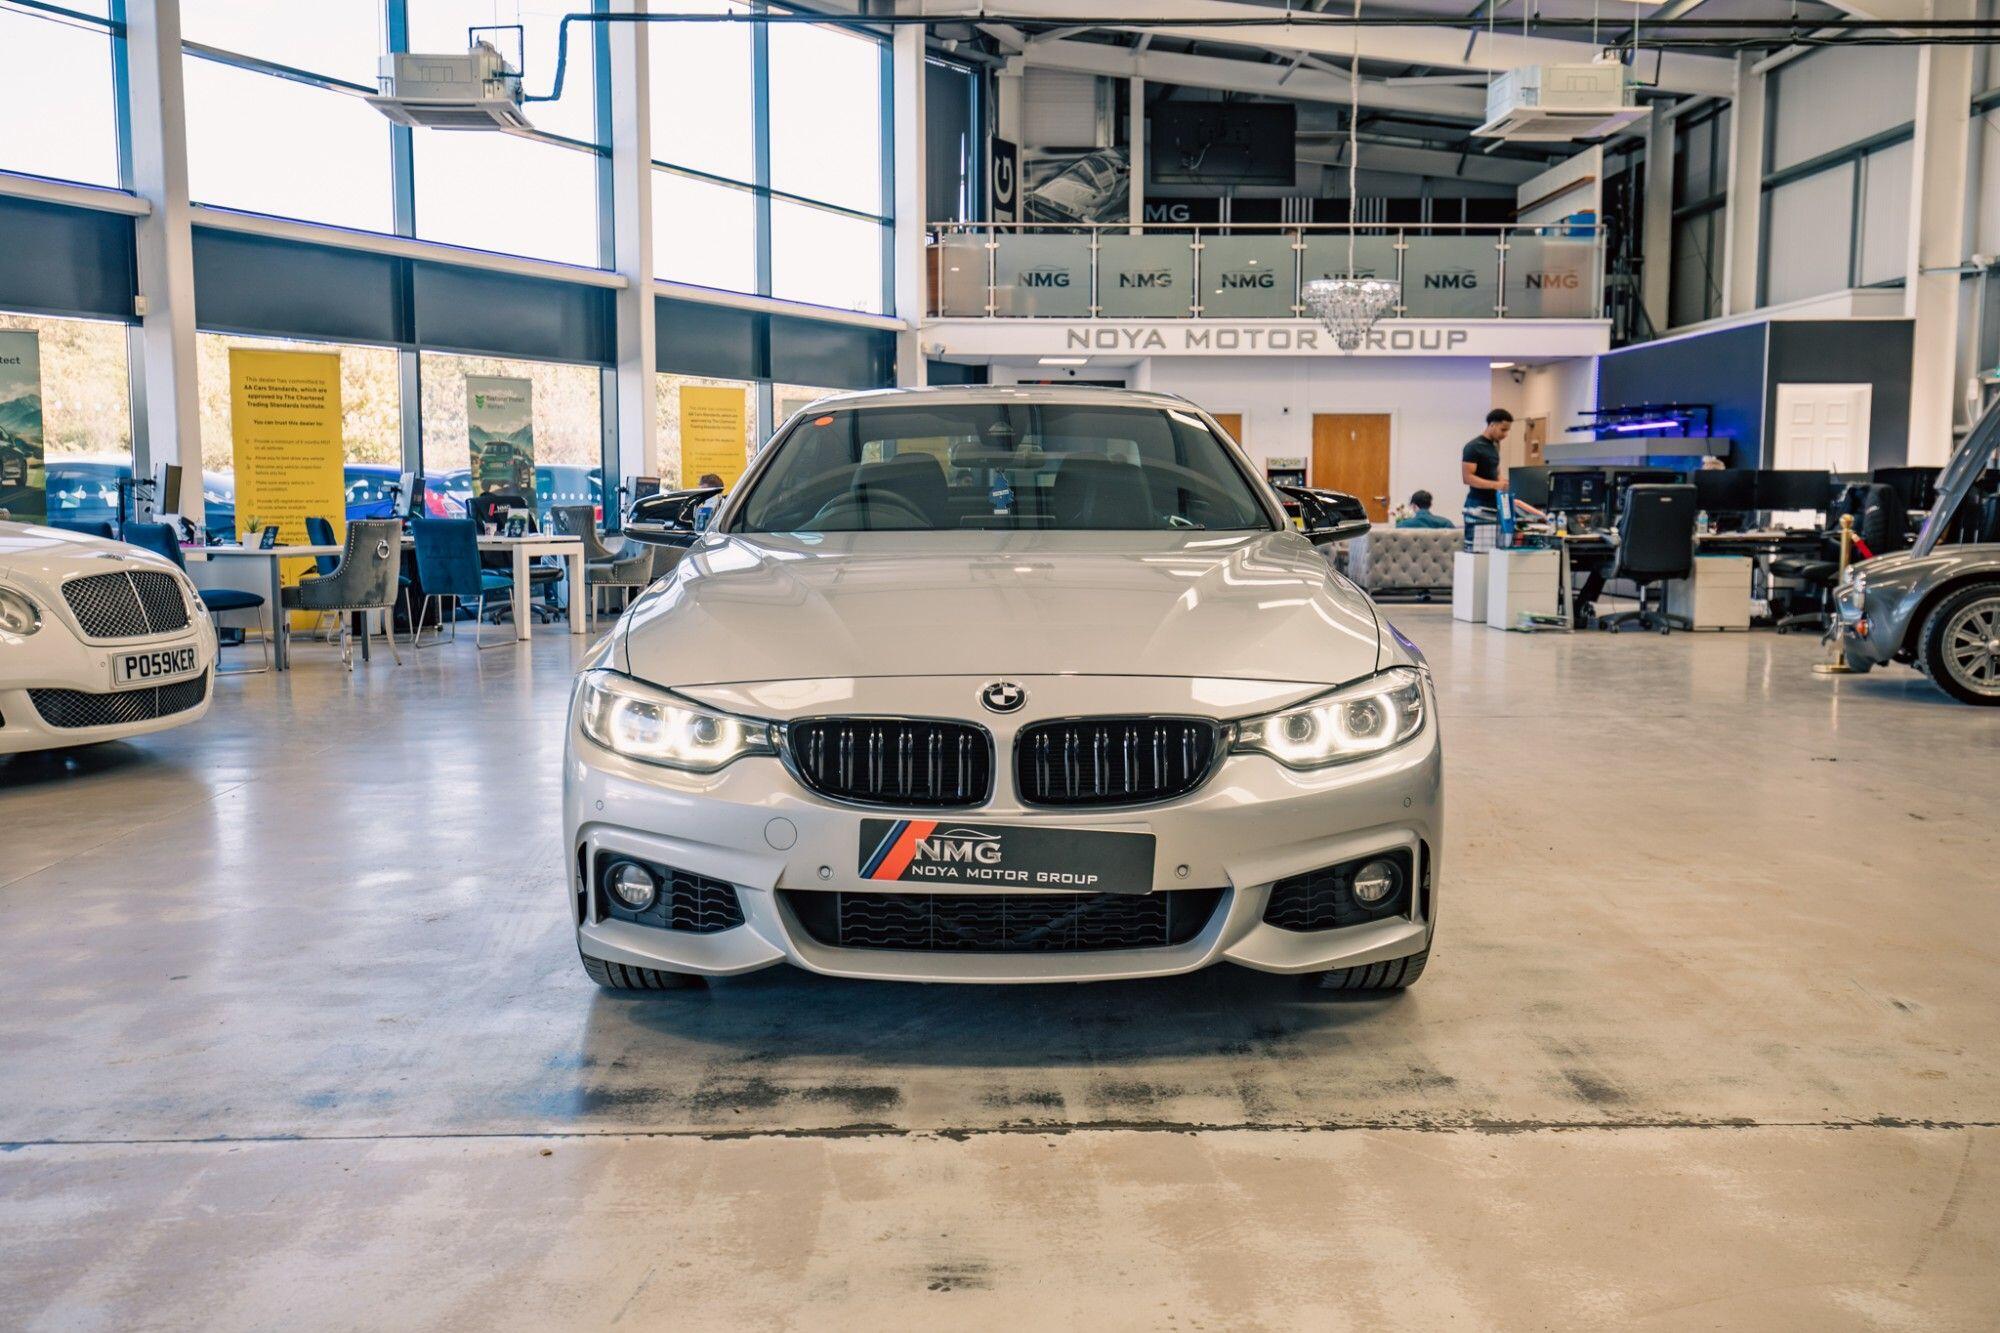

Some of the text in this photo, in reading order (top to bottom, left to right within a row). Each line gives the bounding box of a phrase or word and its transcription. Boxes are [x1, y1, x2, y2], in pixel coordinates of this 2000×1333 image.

[1145, 203, 1190, 222] MG
[1018, 272, 1070, 287] NMG
[1119, 273, 1172, 288] NMG
[1222, 273, 1274, 288] NMG
[1425, 273, 1478, 289] NMG
[1526, 273, 1579, 289] NMG
[1066, 328, 1166, 349] NOYA
[1186, 328, 1318, 349] MOTOR
[247, 401, 269, 409] Trading
[270, 401, 300, 409] Standards
[125, 647, 196, 679] PO59KER
[913, 838, 1001, 864] NMG
[911, 865, 1099, 885] NOYA MOTOR GROUP
